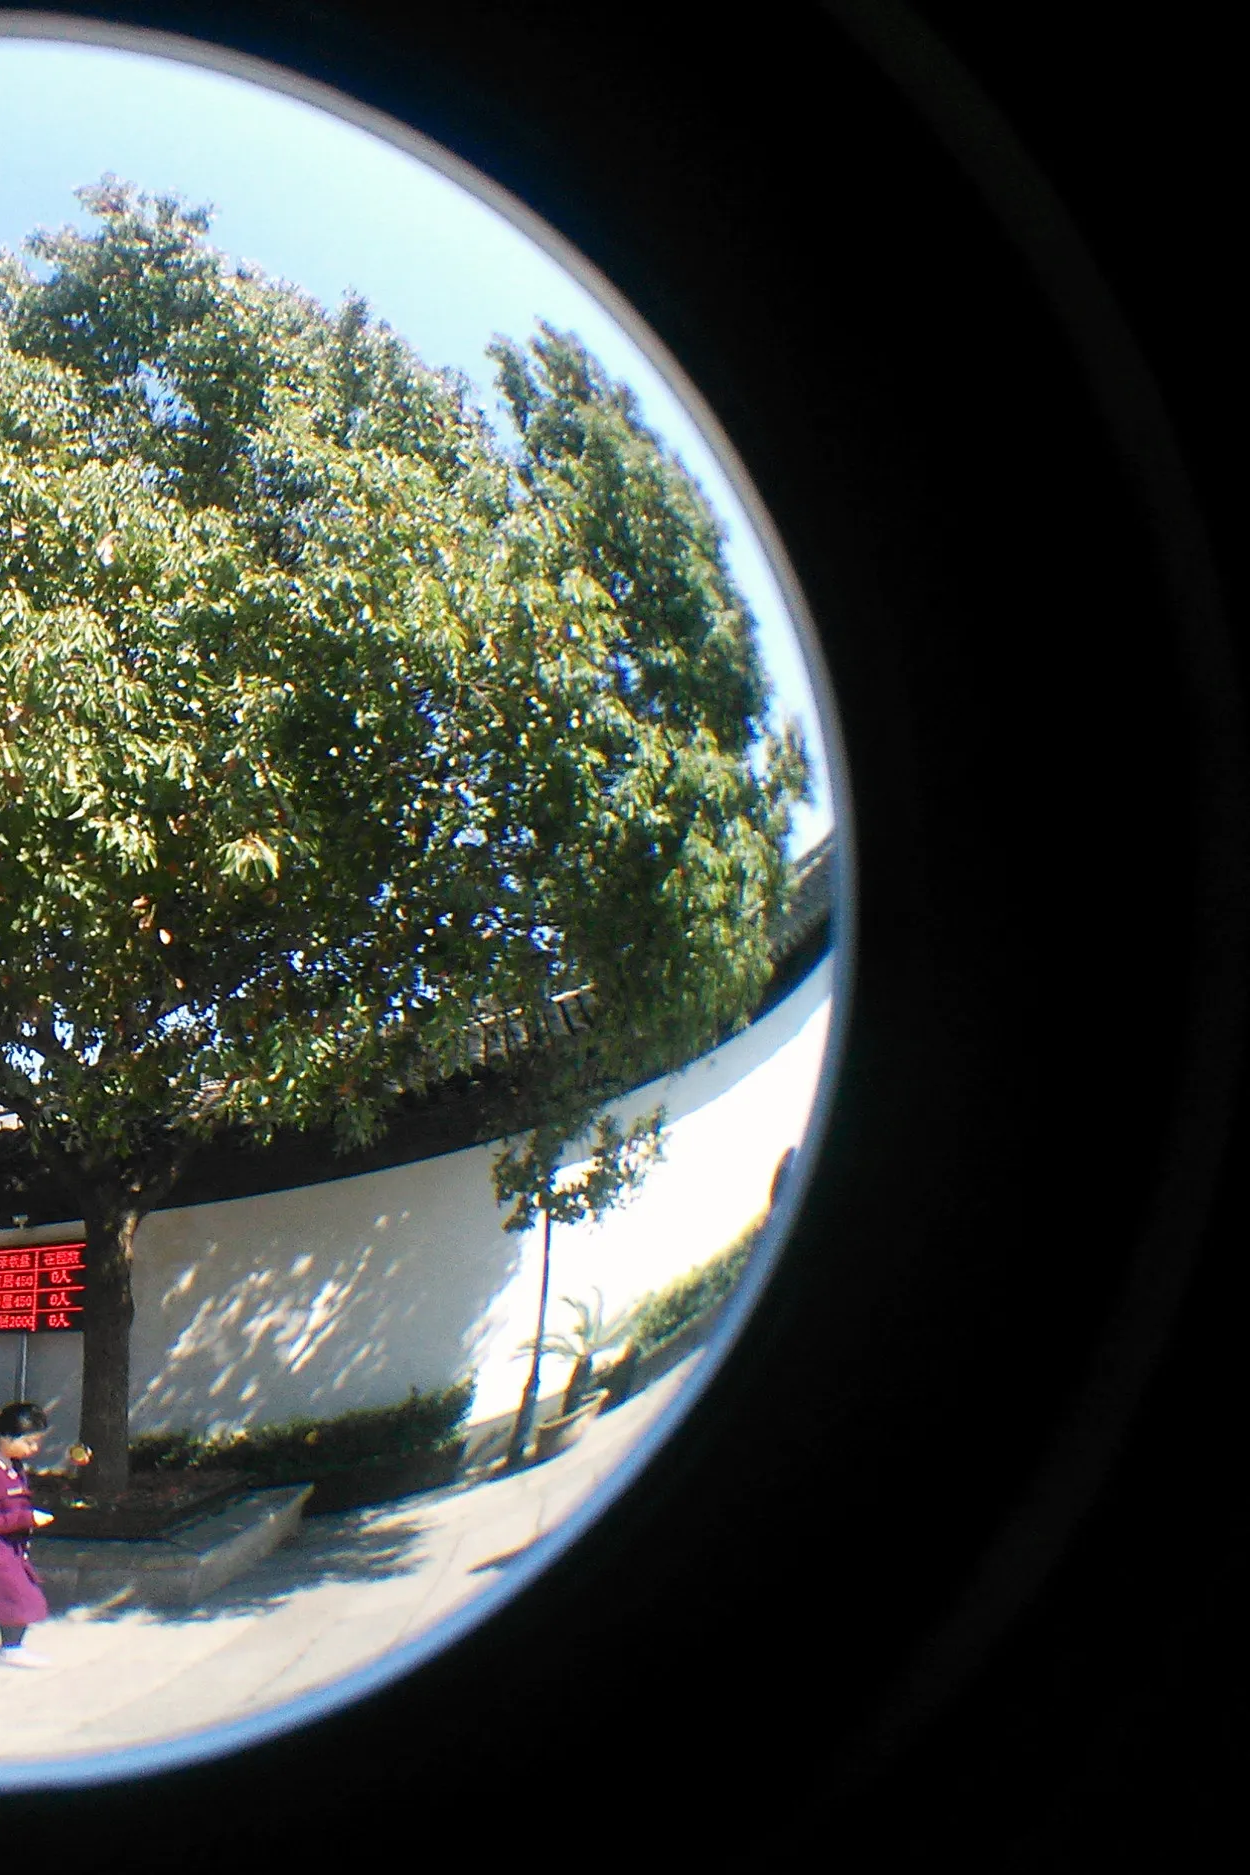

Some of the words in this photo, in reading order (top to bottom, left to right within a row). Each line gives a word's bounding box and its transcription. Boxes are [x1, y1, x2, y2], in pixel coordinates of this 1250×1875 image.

[50, 1269, 72, 1284] 0人
[49, 1291, 71, 1307] 0人
[48, 1312, 70, 1328] 0人
